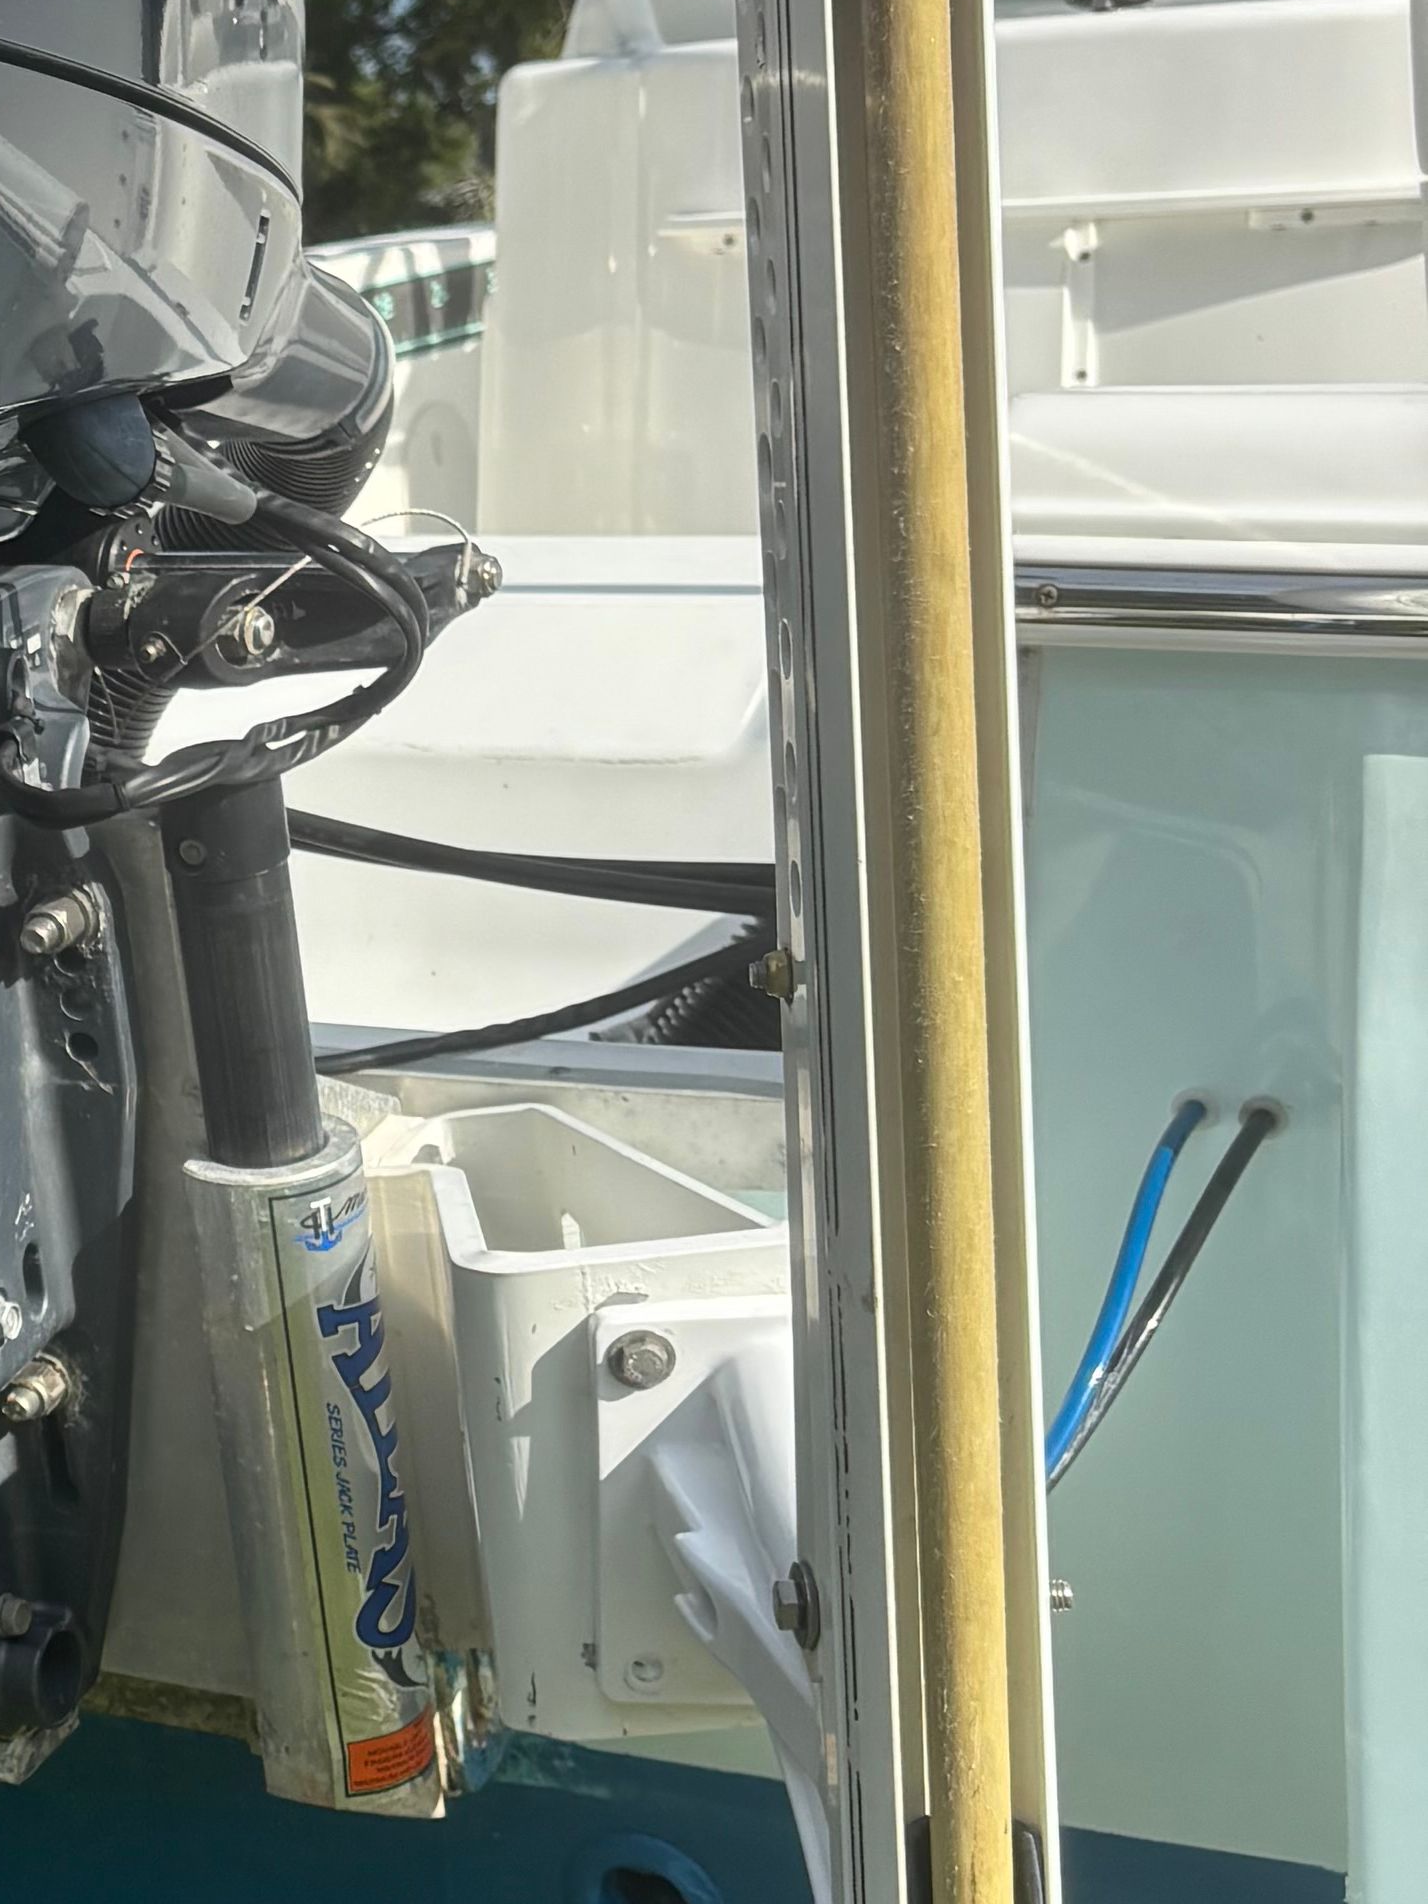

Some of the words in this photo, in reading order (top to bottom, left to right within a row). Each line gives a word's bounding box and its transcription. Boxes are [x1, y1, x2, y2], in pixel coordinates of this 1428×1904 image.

[326, 1402, 347, 1468] SERIES
[335, 1470, 351, 1518] JACK
[343, 1519, 362, 1574] PLATE
